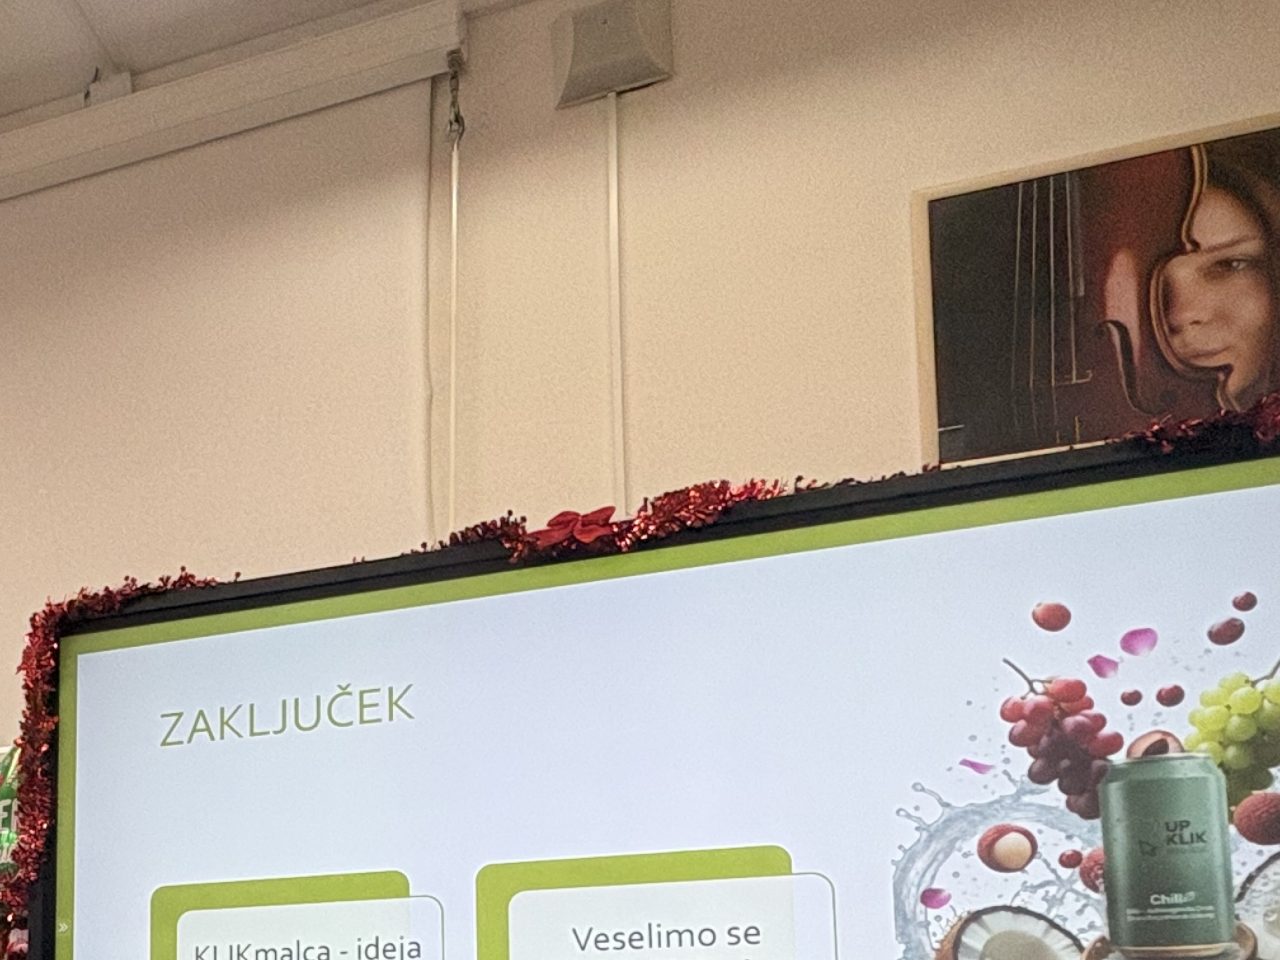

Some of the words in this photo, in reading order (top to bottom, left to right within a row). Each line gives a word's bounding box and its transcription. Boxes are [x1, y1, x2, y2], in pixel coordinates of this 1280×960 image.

[160, 683, 415, 747] ZAKLJUČEK
[1165, 820, 1191, 833] UP
[1166, 830, 1208, 846] KLIK
[572, 922, 717, 951] Veselimo
[727, 925, 761, 946] se
